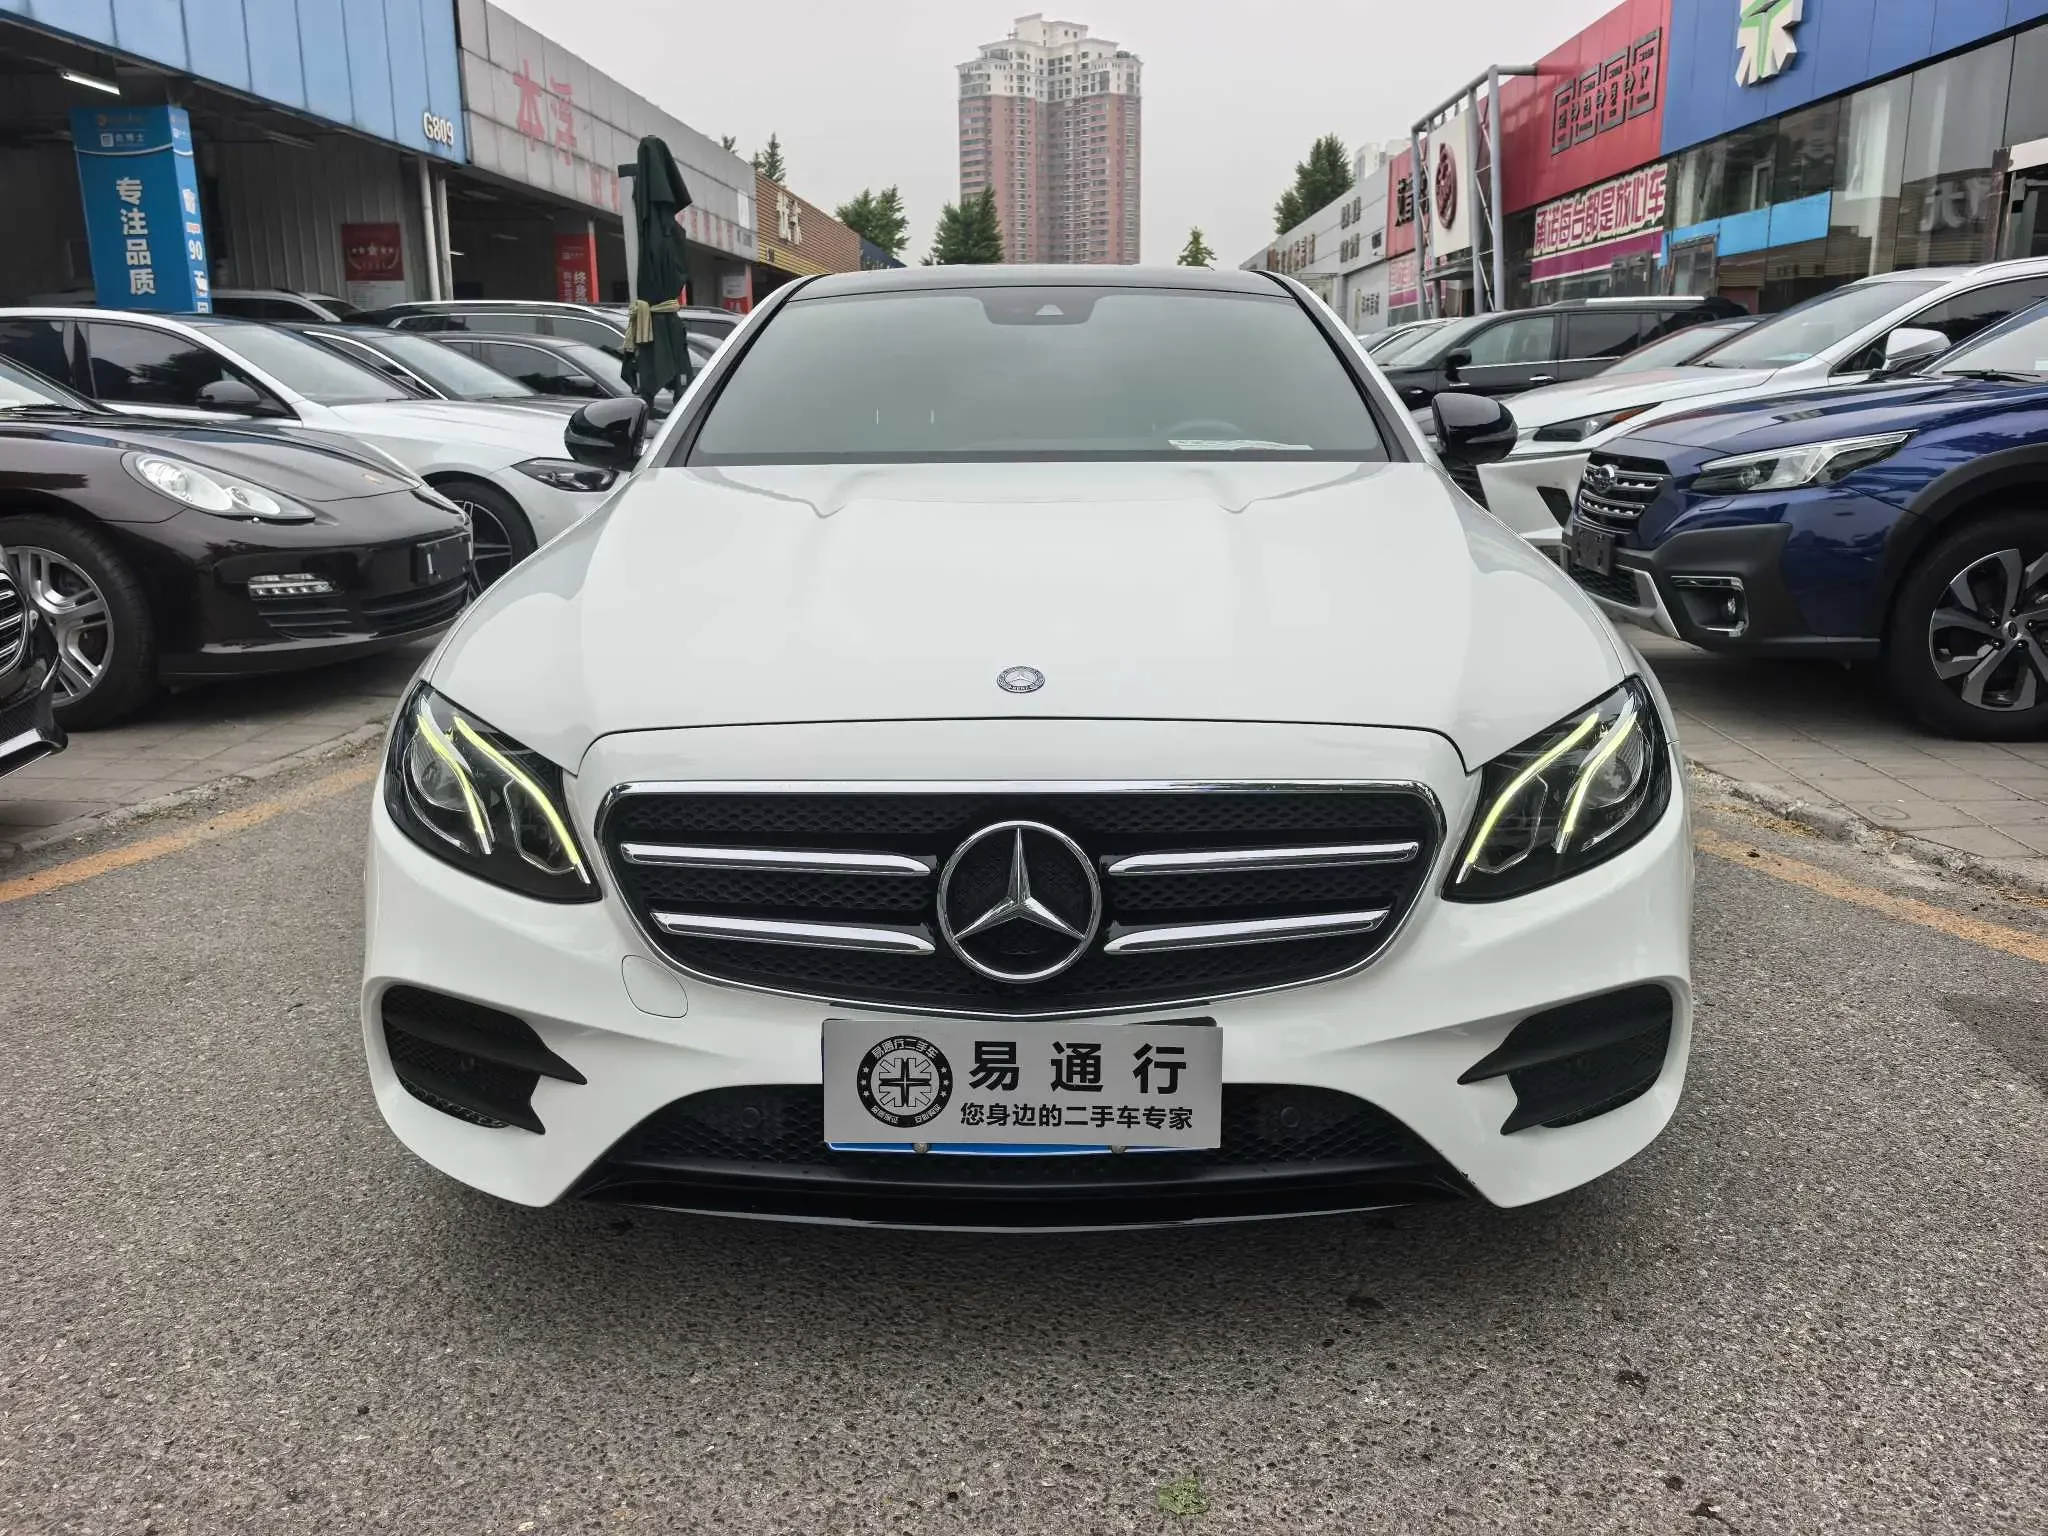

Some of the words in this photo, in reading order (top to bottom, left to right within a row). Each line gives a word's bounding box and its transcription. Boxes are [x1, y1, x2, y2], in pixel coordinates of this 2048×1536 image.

[424, 112, 454, 145] G809
[1535, 165, 1667, 253] 承诺每台都是放心车
[116, 177, 156, 295] 专注品质
[968, 1041, 1187, 1094] 易通行
[960, 1102, 1193, 1130] 您身边的二手车专家
